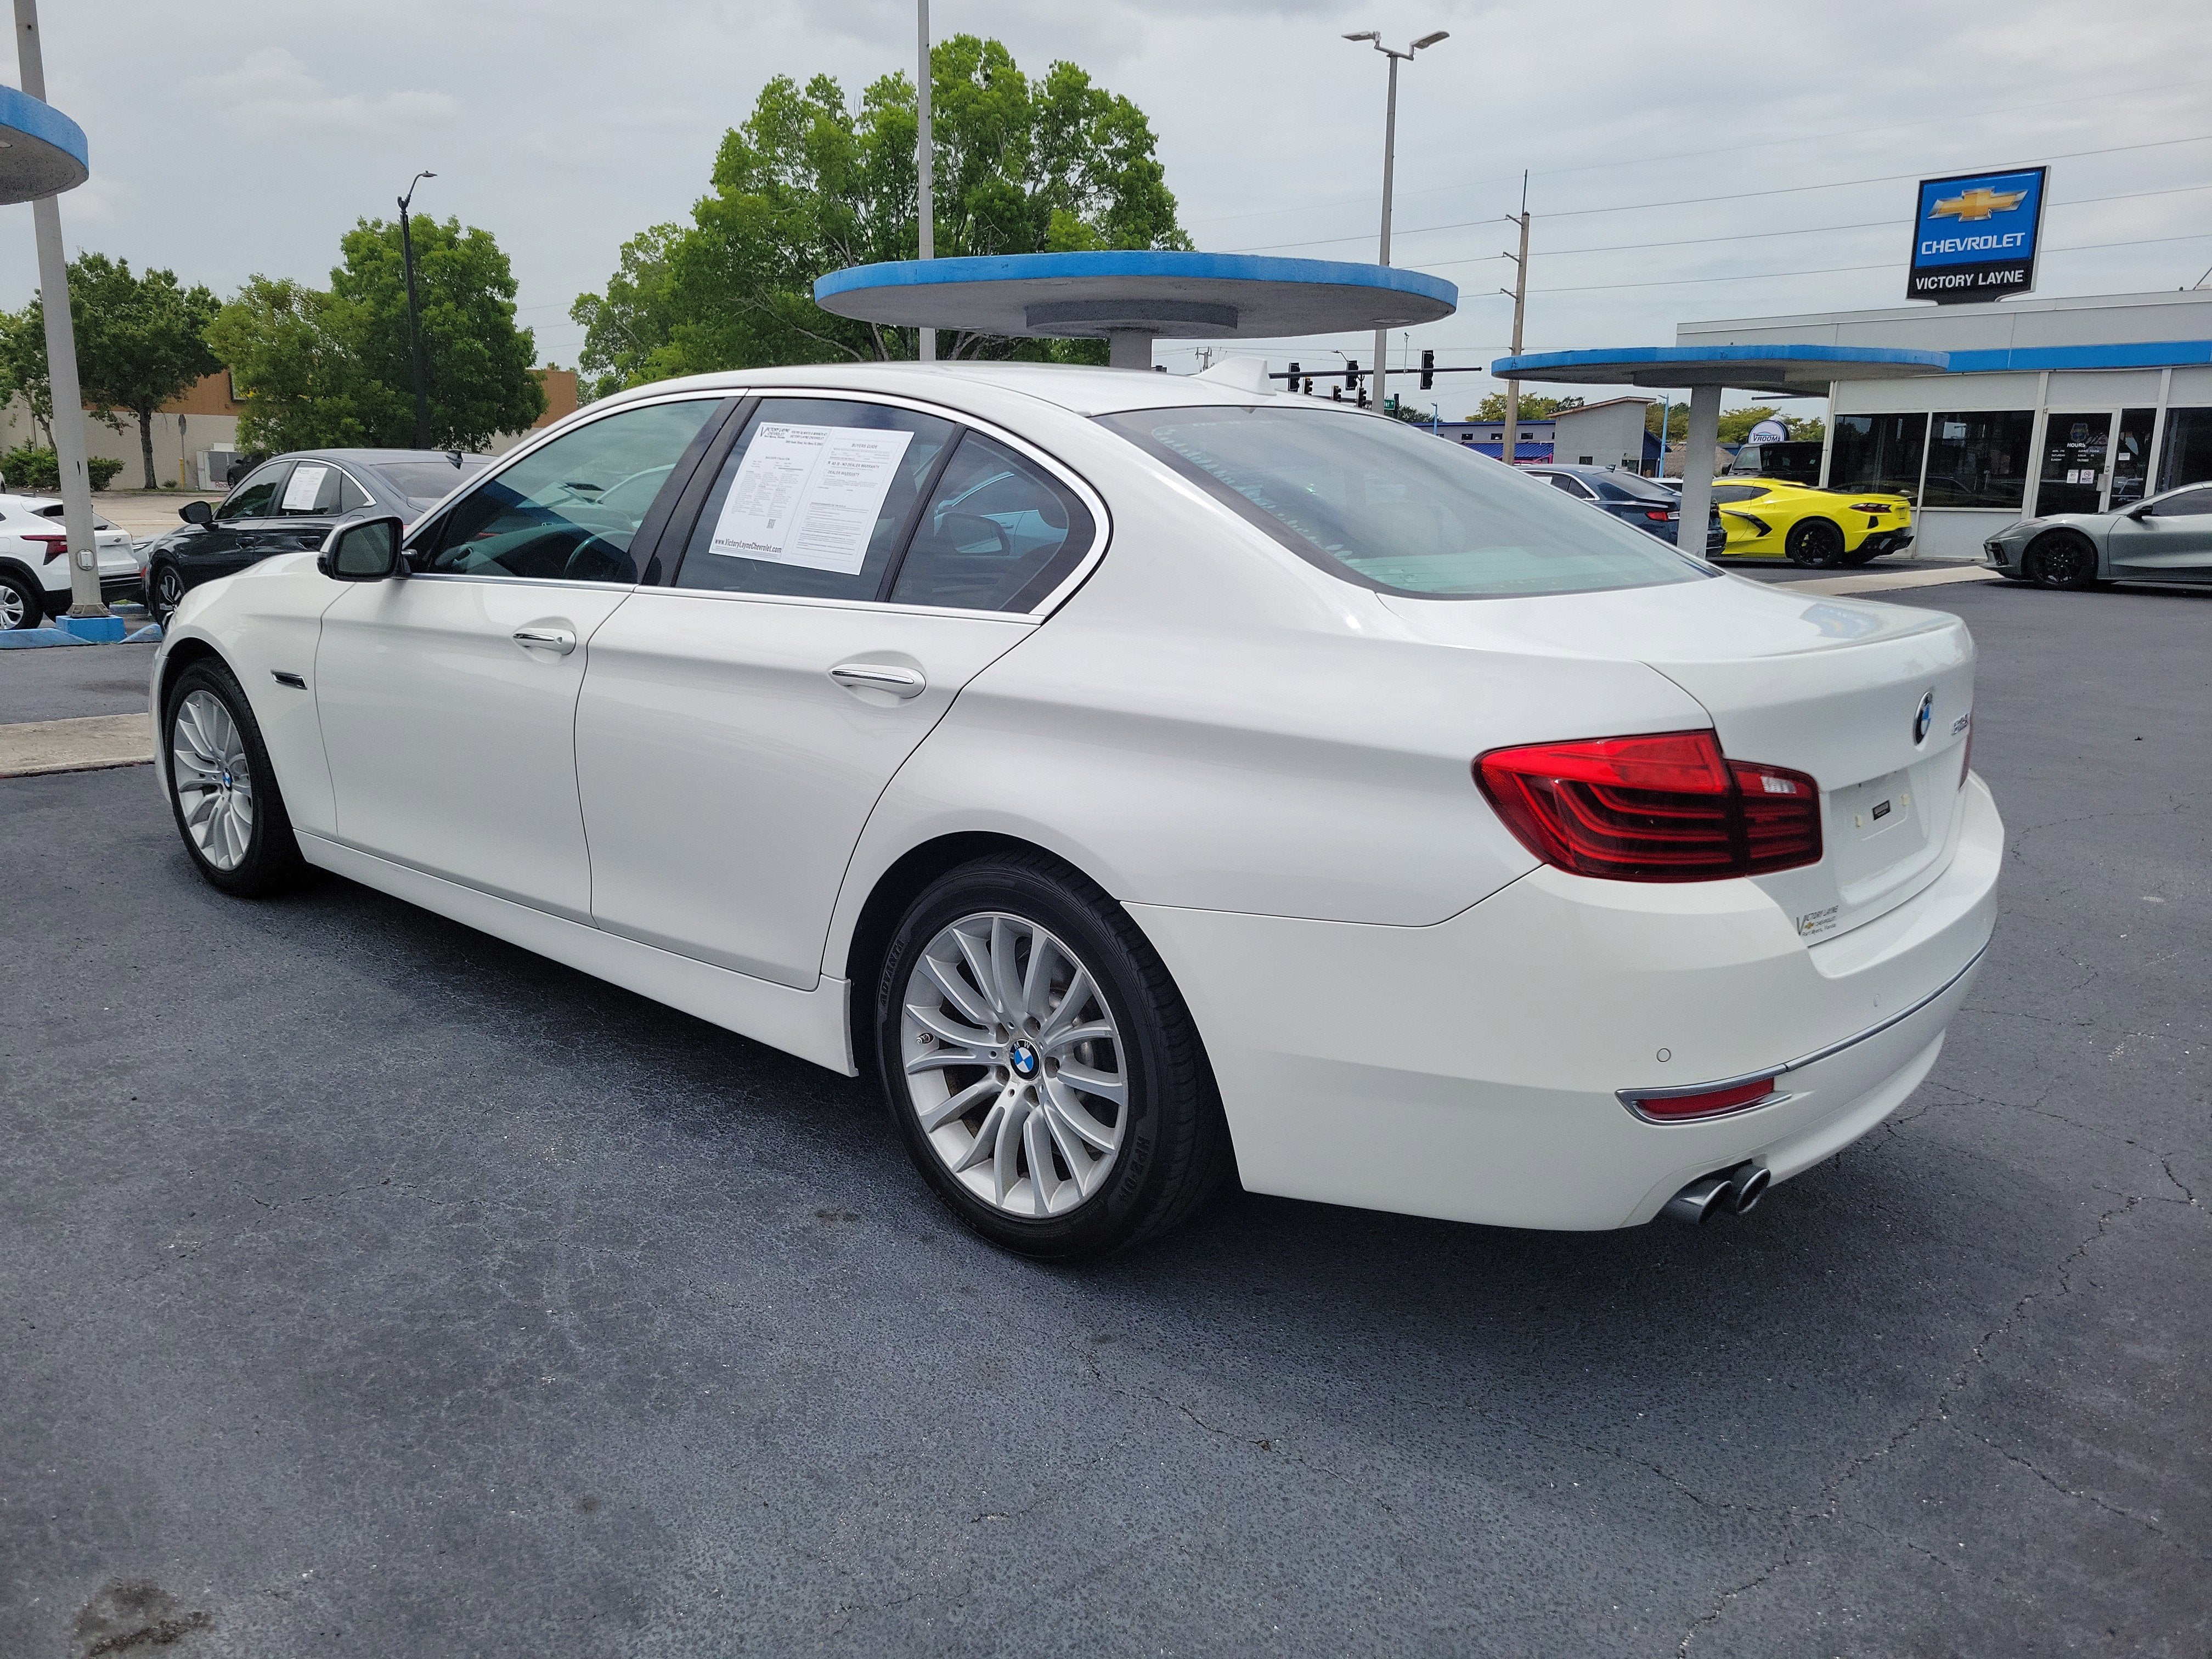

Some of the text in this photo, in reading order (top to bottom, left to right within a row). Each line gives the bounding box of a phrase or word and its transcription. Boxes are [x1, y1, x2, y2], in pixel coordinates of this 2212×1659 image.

[1921, 232, 2025, 255] CHEVROLET
[1916, 269, 2024, 290] VICTORY LAYNE
[715, 538, 782, 554] www.VictoryLayneChevrolet.com
[1010, 1041, 1031, 1059] BMW
